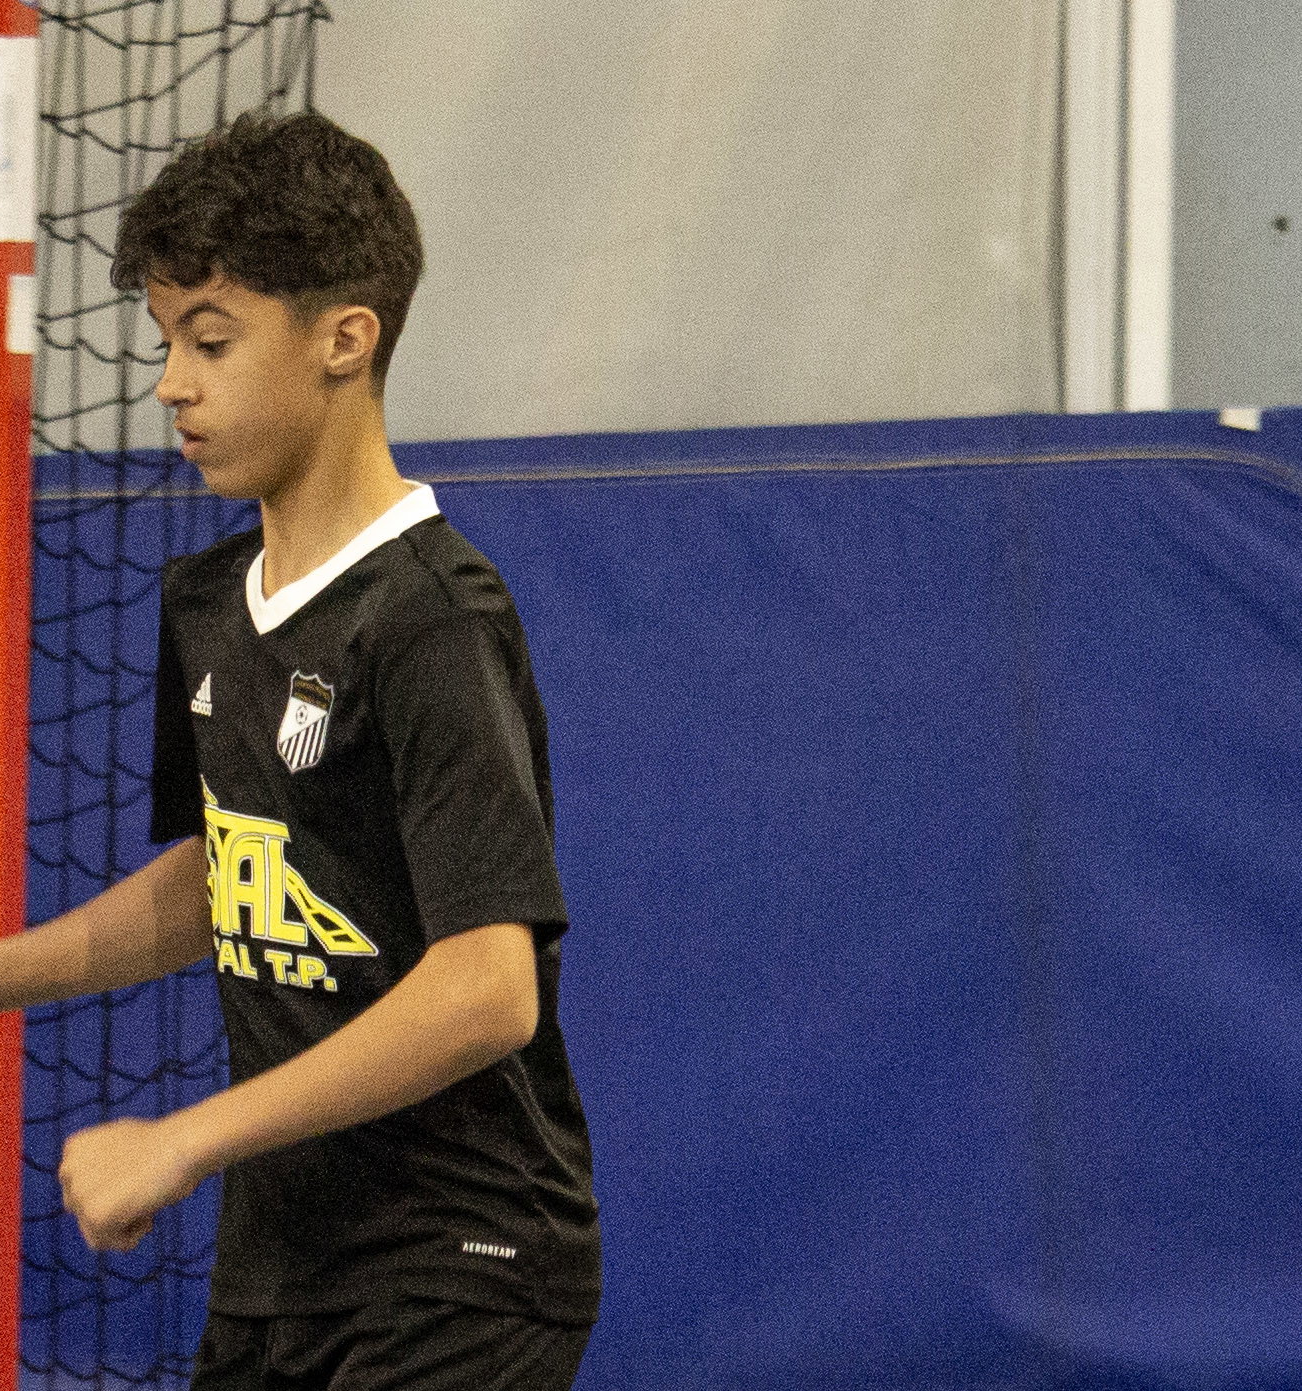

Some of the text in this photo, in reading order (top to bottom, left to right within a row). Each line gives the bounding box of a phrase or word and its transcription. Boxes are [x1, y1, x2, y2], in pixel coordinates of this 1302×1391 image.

[213, 934, 338, 992] AL T.P.
[462, 1241, 516, 1259] AEROREADY
